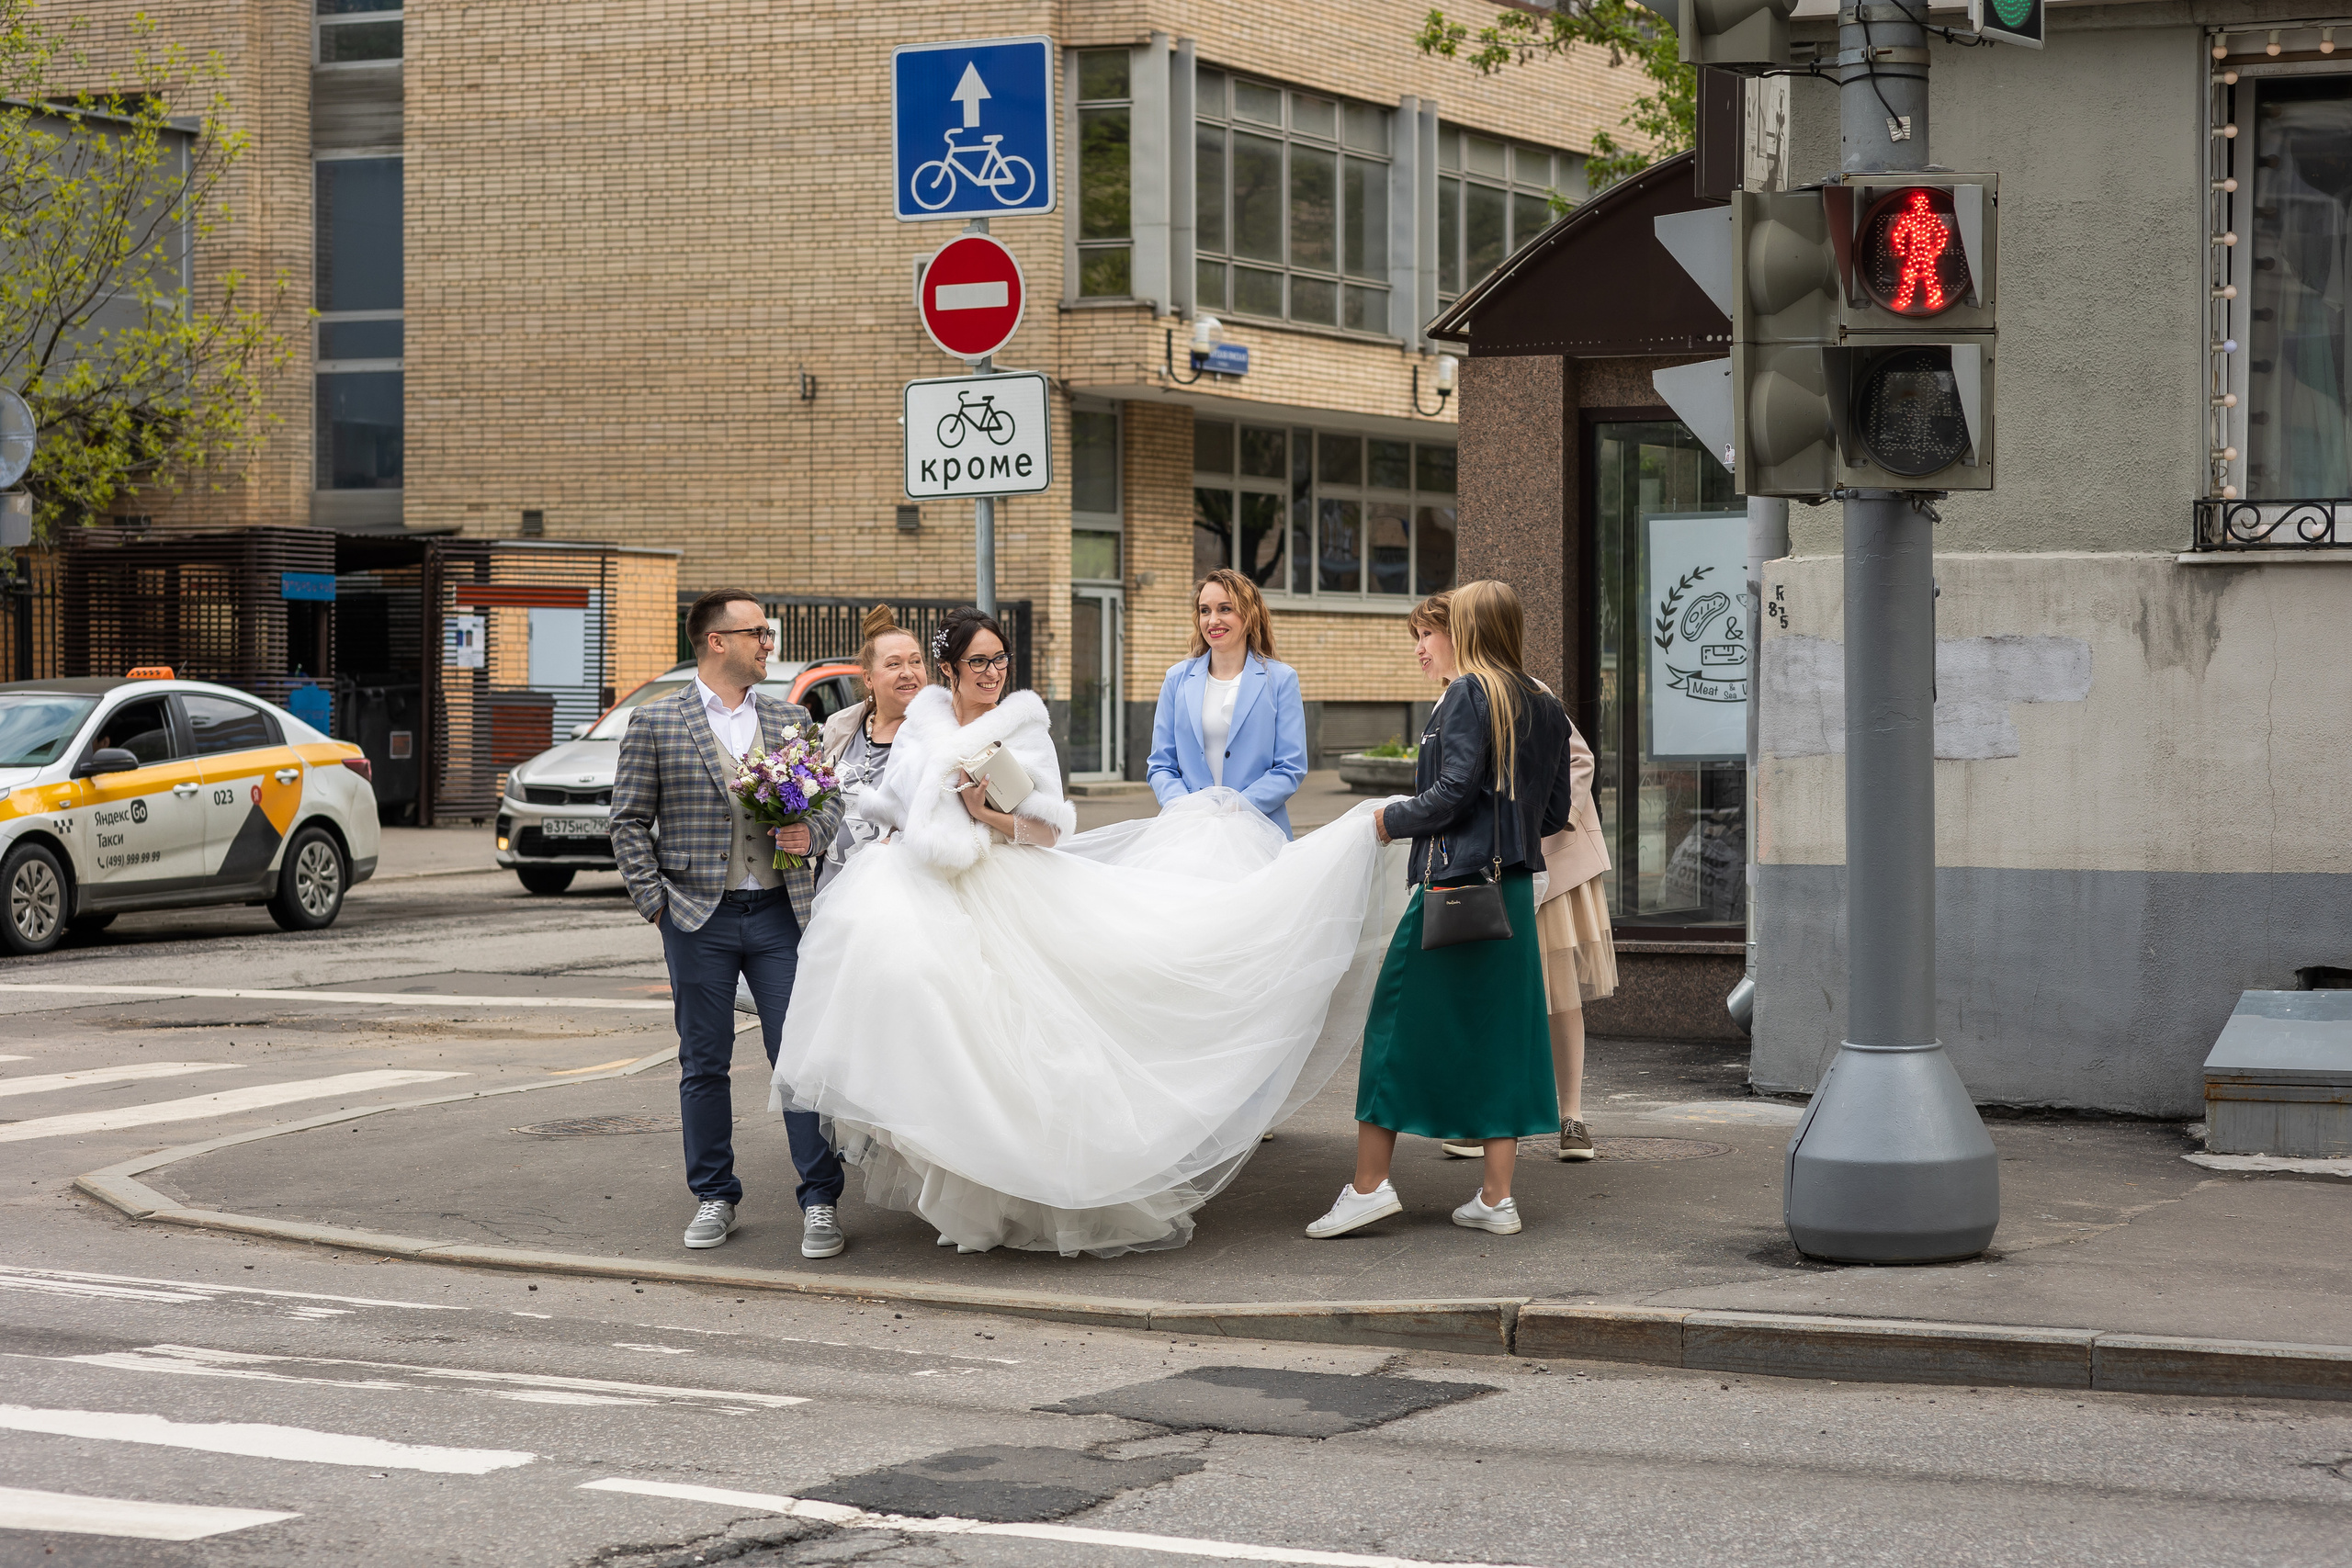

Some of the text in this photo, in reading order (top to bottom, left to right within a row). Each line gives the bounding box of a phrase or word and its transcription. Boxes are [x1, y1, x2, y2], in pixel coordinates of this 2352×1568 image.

[922, 453, 1033, 490] кроме
[1692, 682, 1718, 695] Meat
[1724, 691, 1737, 700] Sea
[214, 789, 234, 806] 023
[95, 804, 146, 827] Яндекс Go
[96, 833, 124, 849] Такси
[106, 851, 161, 869] (499) 999 99 99
